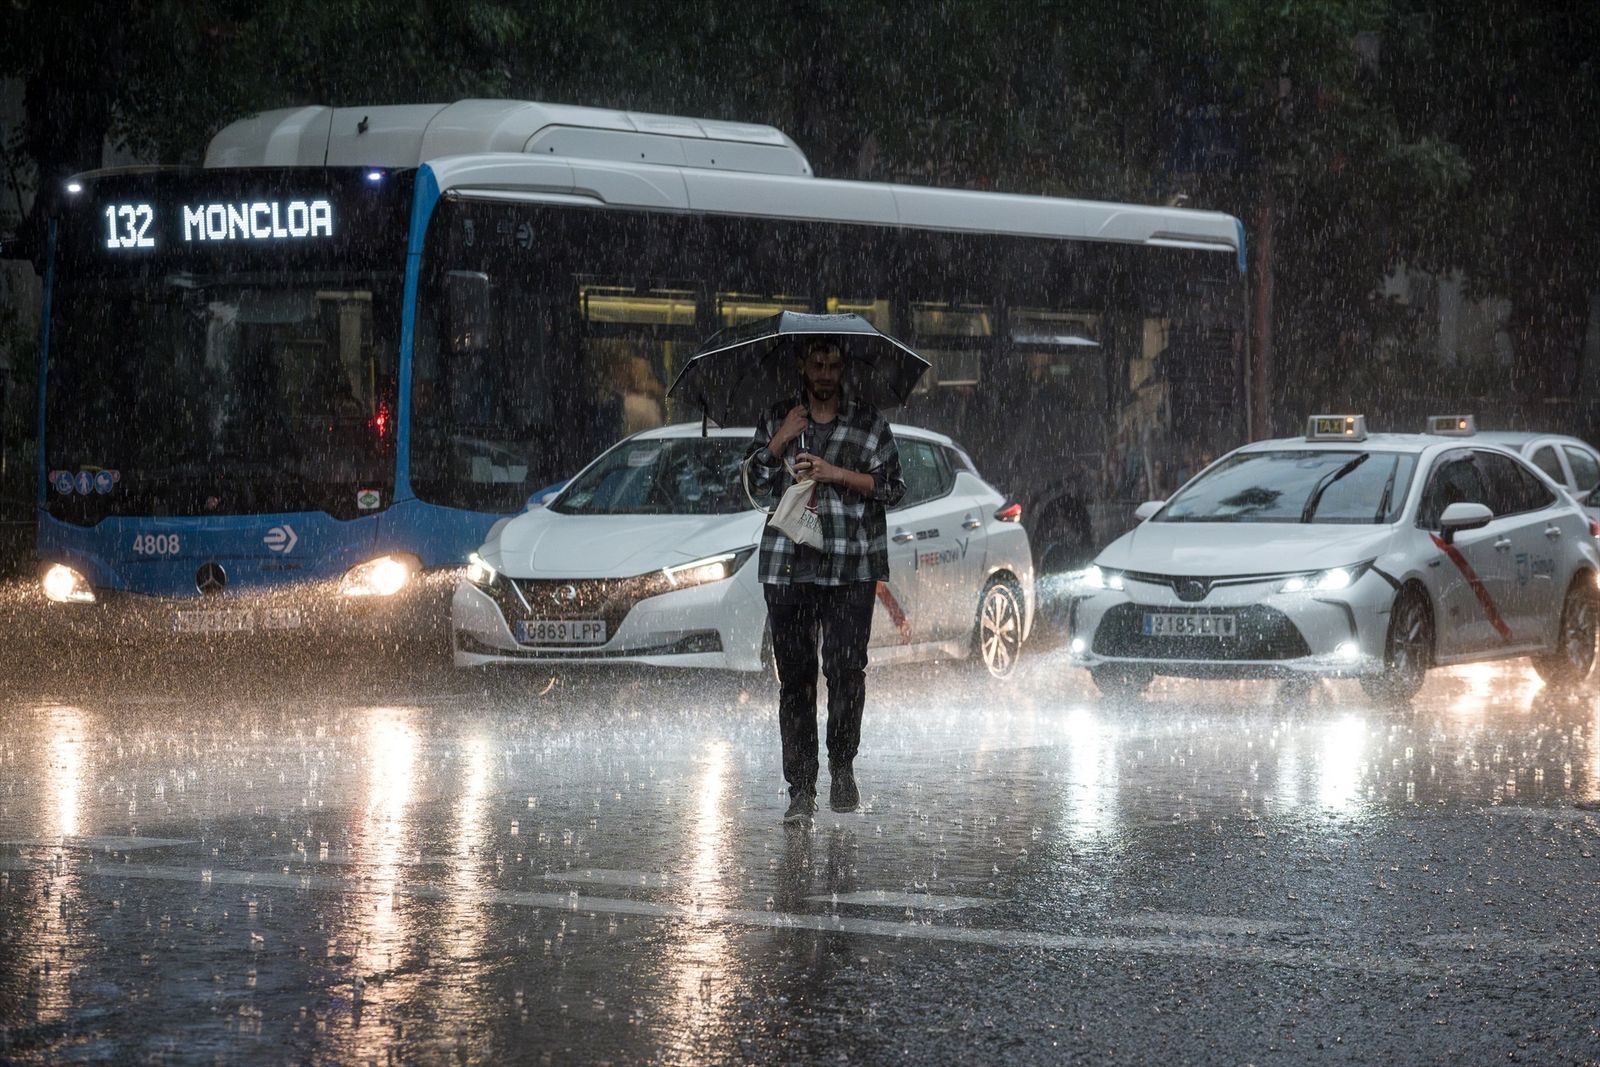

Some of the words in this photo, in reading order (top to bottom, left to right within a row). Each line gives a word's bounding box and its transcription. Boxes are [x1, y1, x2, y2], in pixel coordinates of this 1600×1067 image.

[106, 204, 155, 248] 132
[183, 200, 333, 241] MONCLOA
[132, 534, 180, 554] 4808
[527, 623, 567, 639] 0869
[572, 623, 602, 639] LPP
